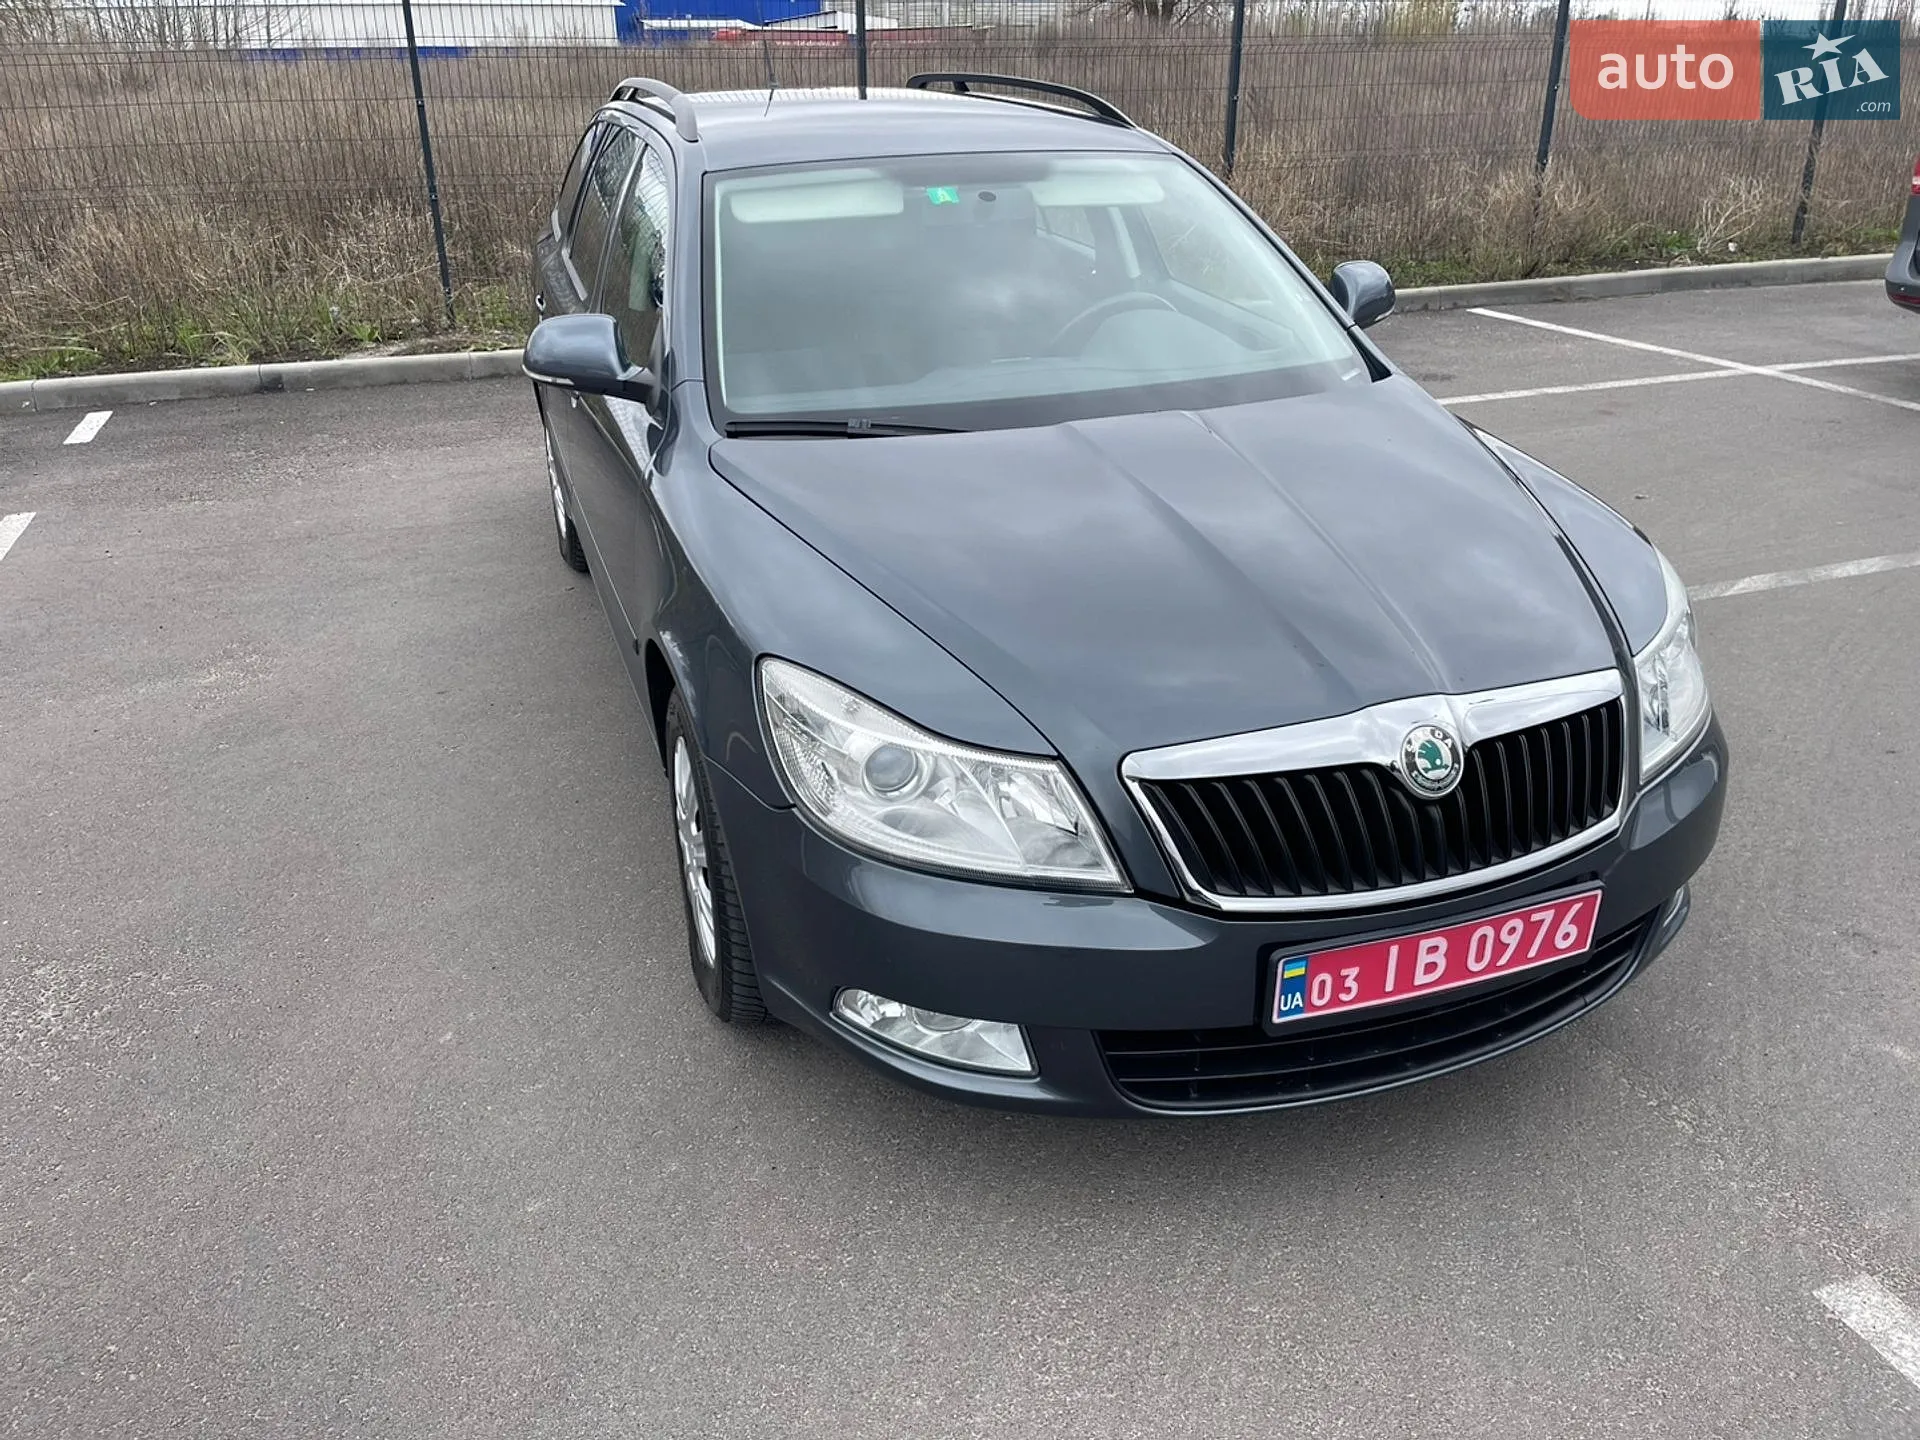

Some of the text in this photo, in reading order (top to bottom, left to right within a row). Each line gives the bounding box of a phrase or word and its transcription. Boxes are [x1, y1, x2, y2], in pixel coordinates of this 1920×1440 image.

[1310, 902, 1583, 1007] 03 IB 0976
[1280, 991, 1304, 1011] UA
